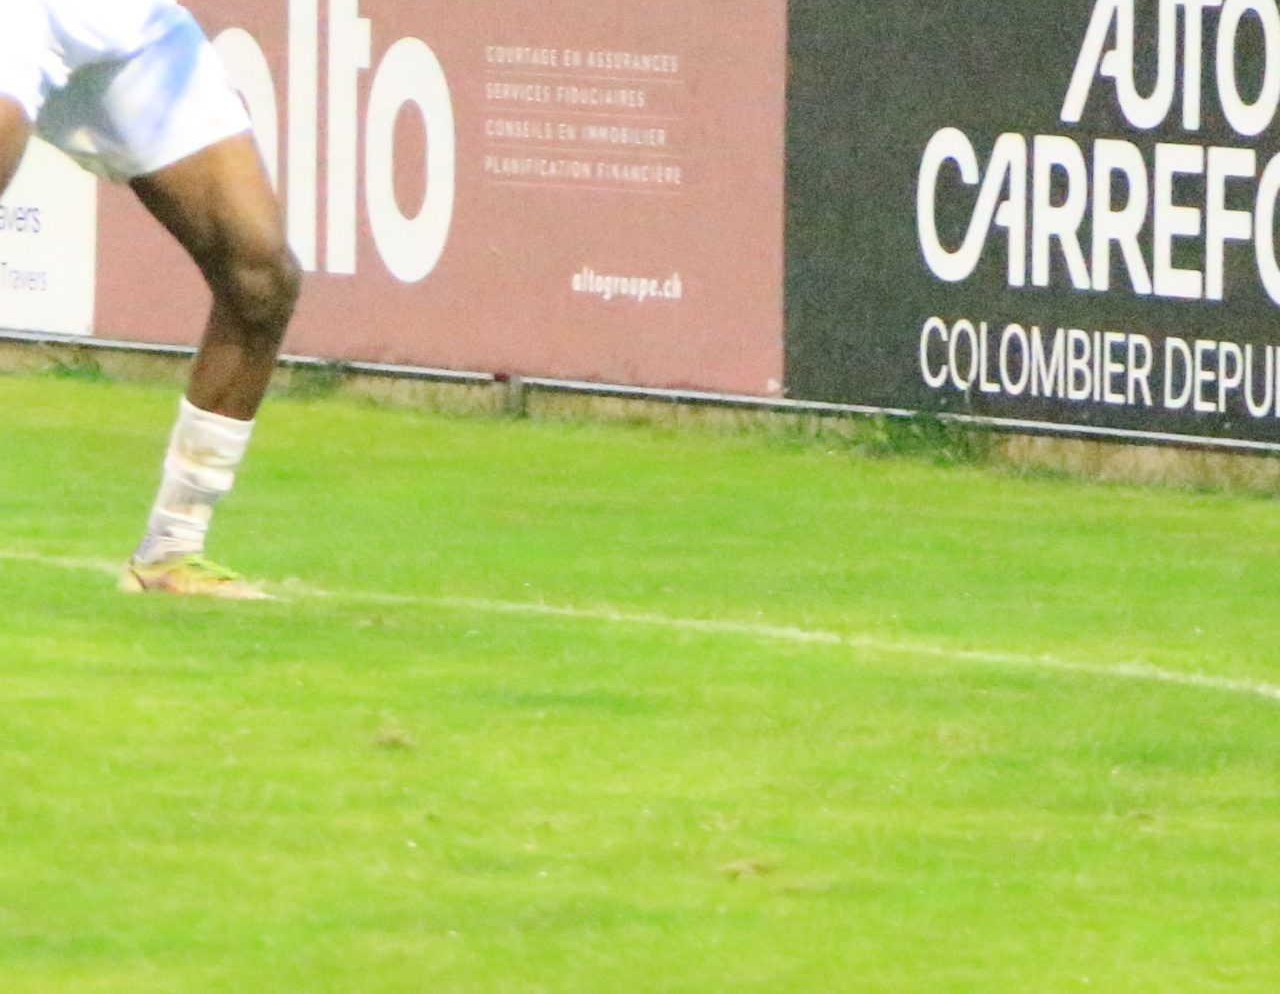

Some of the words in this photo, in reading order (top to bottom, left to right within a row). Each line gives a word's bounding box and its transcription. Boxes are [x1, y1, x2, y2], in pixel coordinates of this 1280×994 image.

[485, 45, 558, 67] COURTAGE
[563, 49, 582, 67] EN
[586, 51, 679, 73] ASSURANCES
[485, 82, 551, 103] SERVICES
[556, 86, 646, 108] FIDUCIAIRES
[484, 119, 553, 140] CONSEILS
[558, 123, 576, 141] EN
[581, 125, 667, 146] IMMOBILIER
[484, 155, 592, 179] PLANIFICATION
[572, 266, 682, 302] altogroupe.ch
[920, 317, 1154, 406] COLOMBIER
